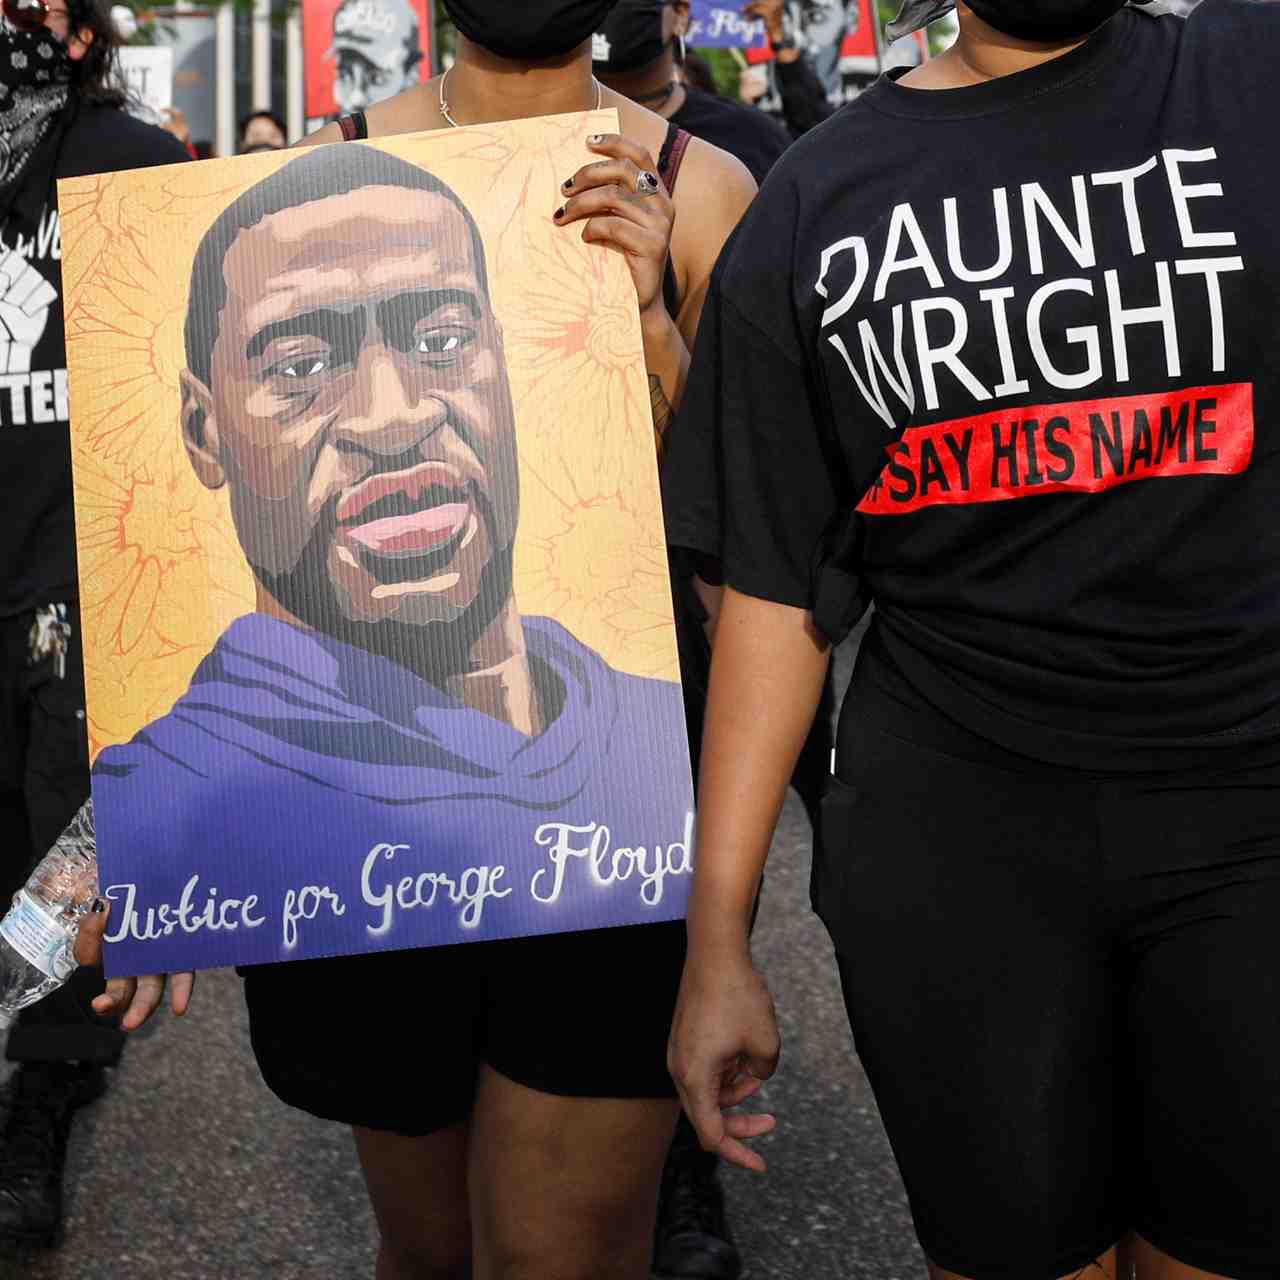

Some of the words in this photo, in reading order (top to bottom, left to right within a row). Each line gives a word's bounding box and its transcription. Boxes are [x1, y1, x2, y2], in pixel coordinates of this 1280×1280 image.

[814, 147, 1238, 328] DAUNTE
[828, 256, 1245, 429] WRIGHT
[991, 416, 1076, 488] HIS
[1088, 398, 1219, 480] NAME
[103, 874, 266, 943] Justice
[283, 885, 346, 947] for
[361, 842, 513, 934] George
[530, 810, 695, 906] Floyd
